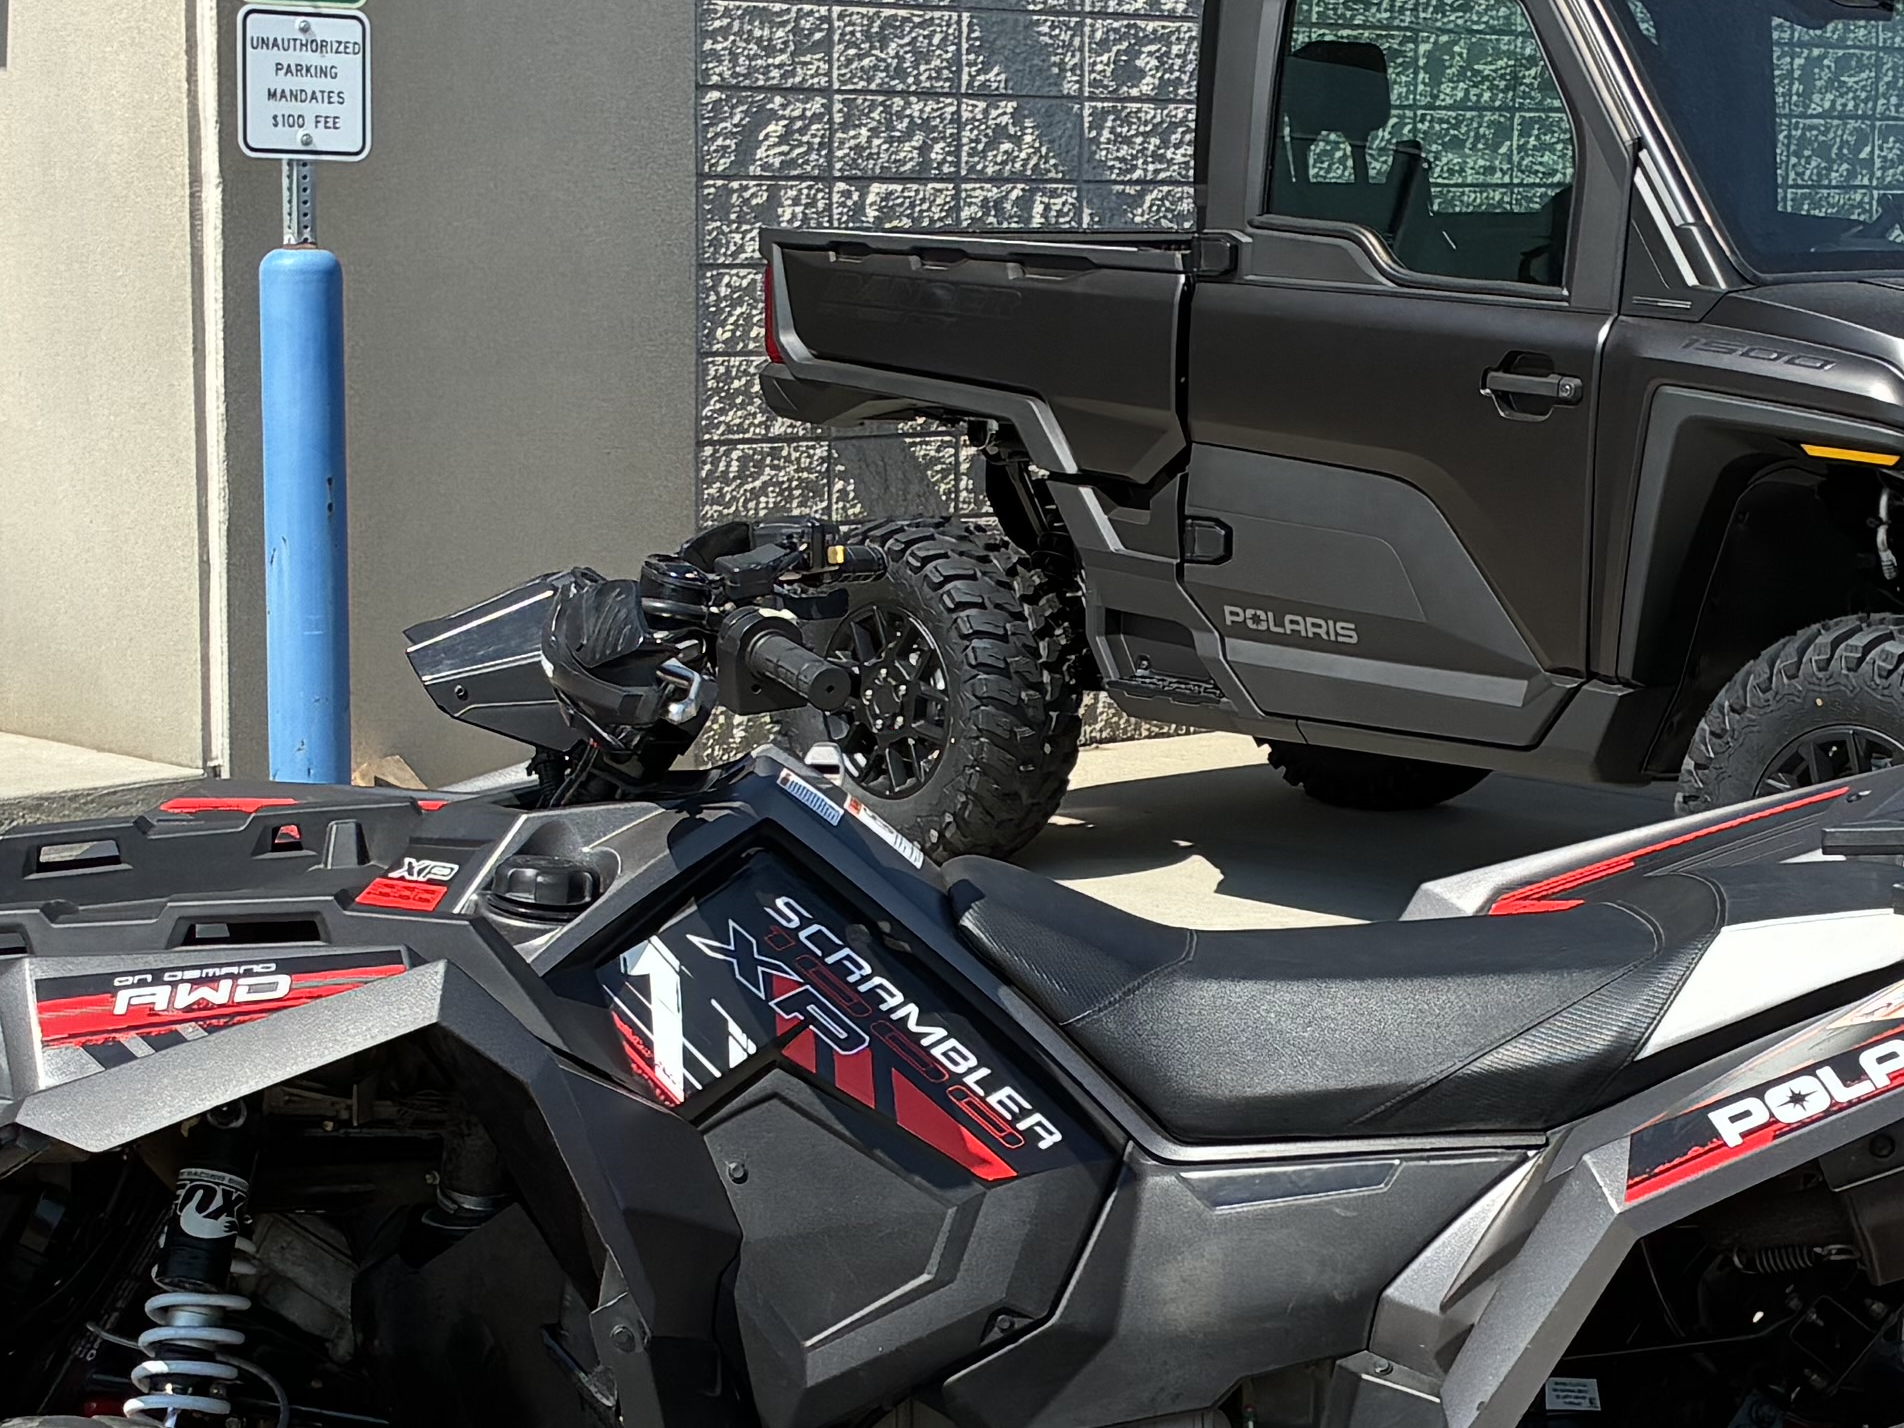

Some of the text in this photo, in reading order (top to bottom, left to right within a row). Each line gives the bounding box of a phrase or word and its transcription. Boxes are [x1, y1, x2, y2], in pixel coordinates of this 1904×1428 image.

[250, 35, 362, 57] UNAUTHORIZED
[275, 62, 339, 81] PARKING
[267, 88, 346, 106] MANDATES
[271, 114, 341, 131] $100 FEE
[1223, 604, 1359, 645] POLARIS
[387, 857, 459, 882] XP
[112, 974, 292, 1016] AWD
[685, 918, 871, 1055] XP
[763, 895, 1063, 1150] SCRAMBLER
